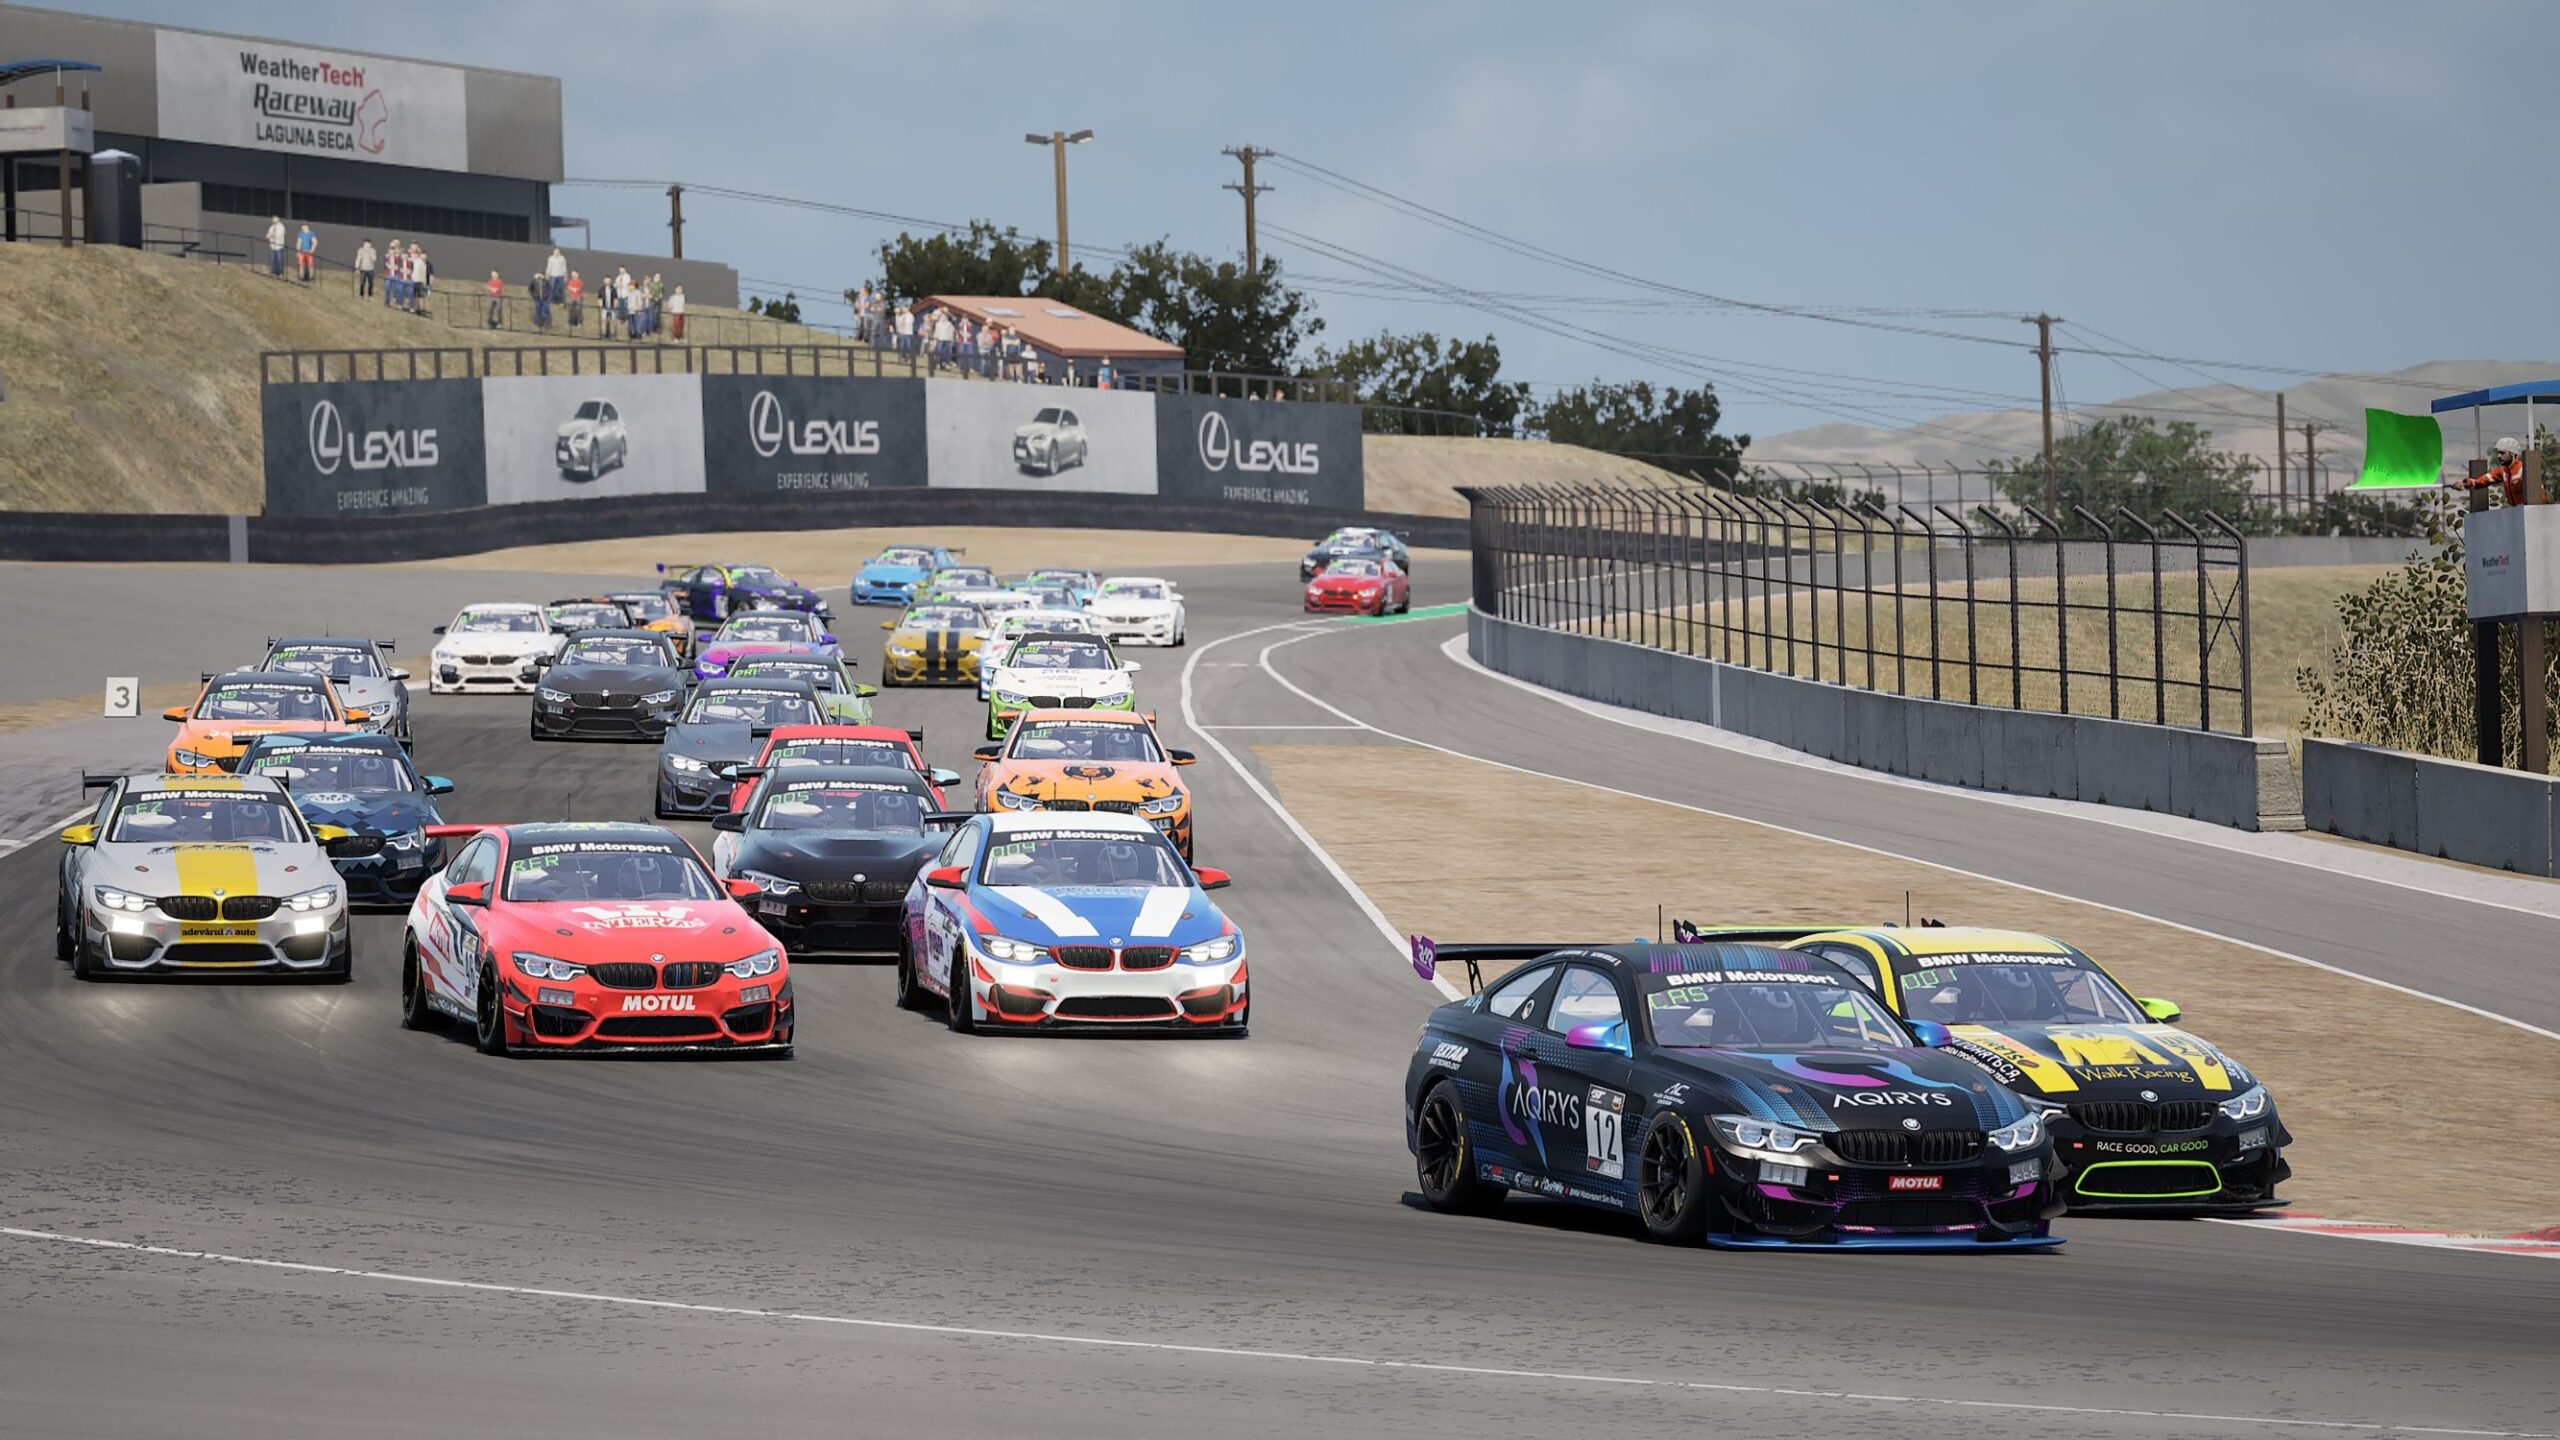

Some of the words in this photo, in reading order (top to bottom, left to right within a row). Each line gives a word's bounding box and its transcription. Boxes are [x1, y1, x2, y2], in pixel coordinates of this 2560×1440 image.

[240, 51, 365, 87] WeatherTech
[254, 83, 356, 126] Raceway
[256, 123, 316, 148] LAGUNA
[317, 129, 355, 151] SECA
[788, 420, 880, 454] LEXUS
[348, 429, 439, 470] LEXUS
[1234, 439, 1319, 474] LEXUS
[777, 473, 829, 489] EXPERIENCE
[831, 473, 869, 489] AMAZING
[337, 489, 389, 510] EXPERIENCE
[391, 487, 429, 507] AMAZING
[1223, 485, 1272, 504] EXPERIENCE
[1273, 488, 1310, 505] AMAZING
[114, 686, 130, 709] 3
[711, 689, 740, 697] BMW
[741, 689, 801, 698] Motorsport
[271, 745, 308, 755] BMW
[309, 745, 384, 756] Motorsport
[788, 738, 822, 747] BMW
[824, 738, 894, 748] Motorsport
[788, 782, 827, 792] BMW
[828, 781, 909, 792] Motorsport
[140, 791, 182, 801] BMW
[184, 790, 269, 801] Motorsport
[1010, 831, 1054, 842] BMW
[1056, 830, 1146, 842] Motorsport
[531, 843, 577, 855] BMW
[579, 842, 673, 854] Motorsport
[234, 928, 257, 936] auto
[1916, 954, 1970, 968] BMW
[1971, 953, 2077, 967] Motorsport
[1665, 971, 1722, 986] BMW
[1724, 970, 1840, 985] Motorsport
[621, 994, 696, 1012] MOTUL
[1432, 1041, 1469, 1063] TEXTAR
[2074, 1066, 2128, 1082] Walk
[2125, 1066, 2195, 1083] Racing
[1513, 1081, 1580, 1130] AQIRYS
[1833, 1091, 1952, 1108] AQIRYS
[1593, 1110, 1617, 1162] 12
[2096, 1140, 2122, 1152] RACE
[2125, 1143, 2159, 1155] GOOD,
[2160, 1143, 2179, 1153] CAR
[2180, 1140, 2208, 1152] GOOD
[1891, 1177, 1940, 1188] MOTUL
